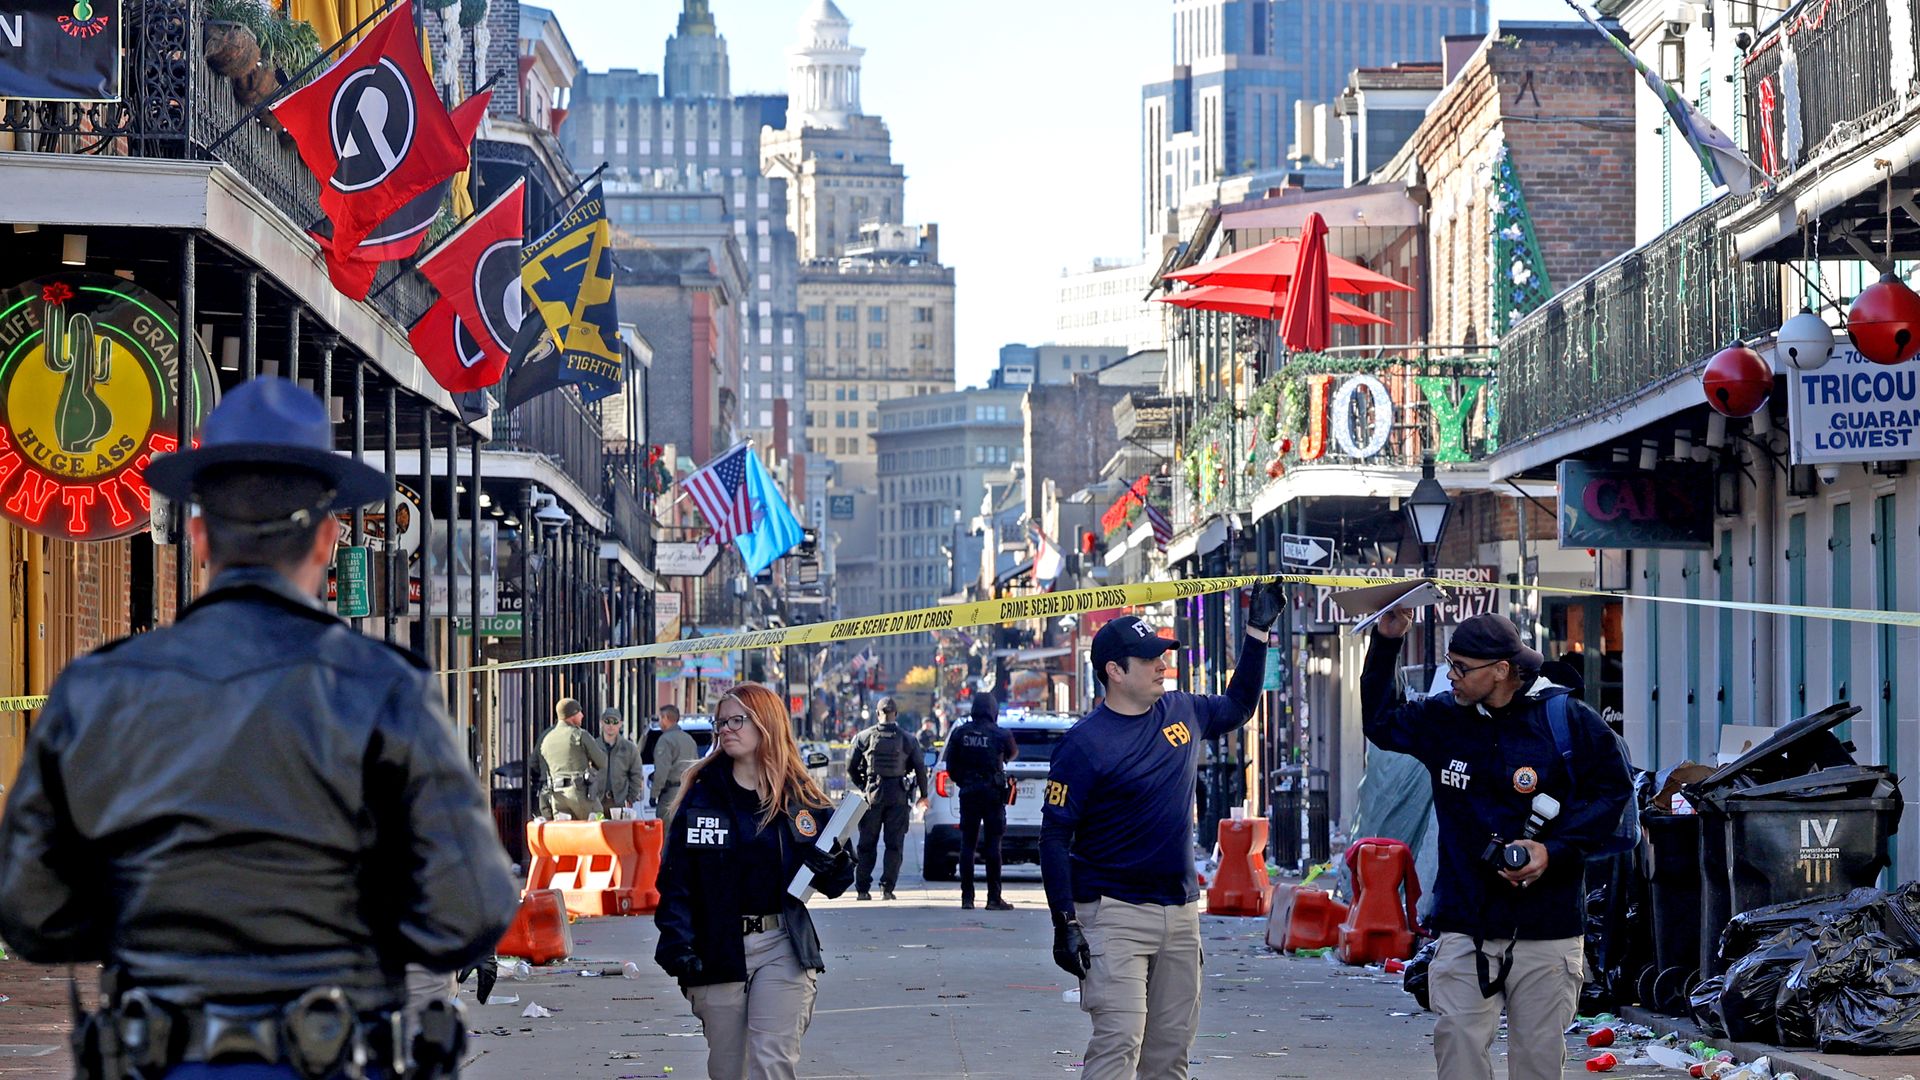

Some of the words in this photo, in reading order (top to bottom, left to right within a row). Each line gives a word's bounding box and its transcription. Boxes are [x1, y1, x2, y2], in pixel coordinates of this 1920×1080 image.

[56, 15, 109, 38] CANTINA
[0, 307, 39, 346] LIFE
[132, 315, 178, 406] GRAND
[1802, 371, 1916, 405] TRICOU
[1300, 374, 1487, 463] JOY
[18, 427, 85, 474] HUGE
[96, 434, 136, 471] ASS
[1815, 429, 1912, 450] LOWEST
[0, 425, 200, 533] ANTIN
[1000, 601, 1028, 619] CRIME
[1031, 597, 1059, 616] SCENE
[1062, 595, 1074, 611] DO
[1077, 592, 1093, 610] NOT
[1097, 589, 1126, 607] CROSS
[830, 622, 860, 638] CRIME
[860, 618, 890, 635] SCENE
[890, 616, 904, 632] DO
[904, 613, 923, 630] NOT
[923, 609, 953, 628] CROSS
[667, 642, 695, 653] CRIME
[695, 639, 723, 651] SCENE
[723, 637, 737, 649] DO
[737, 634, 759, 648] NOT
[756, 630, 787, 645] CROSS
[963, 735, 989, 748] SWAT
[1162, 721, 1190, 748] FBI
[1441, 768, 1470, 790] ERT
[1449, 759, 1467, 774] FBI
[1047, 780, 1068, 807] FBI
[697, 816, 719, 828] FBI
[1800, 819, 1838, 847] IV
[687, 828, 728, 845] ERT
